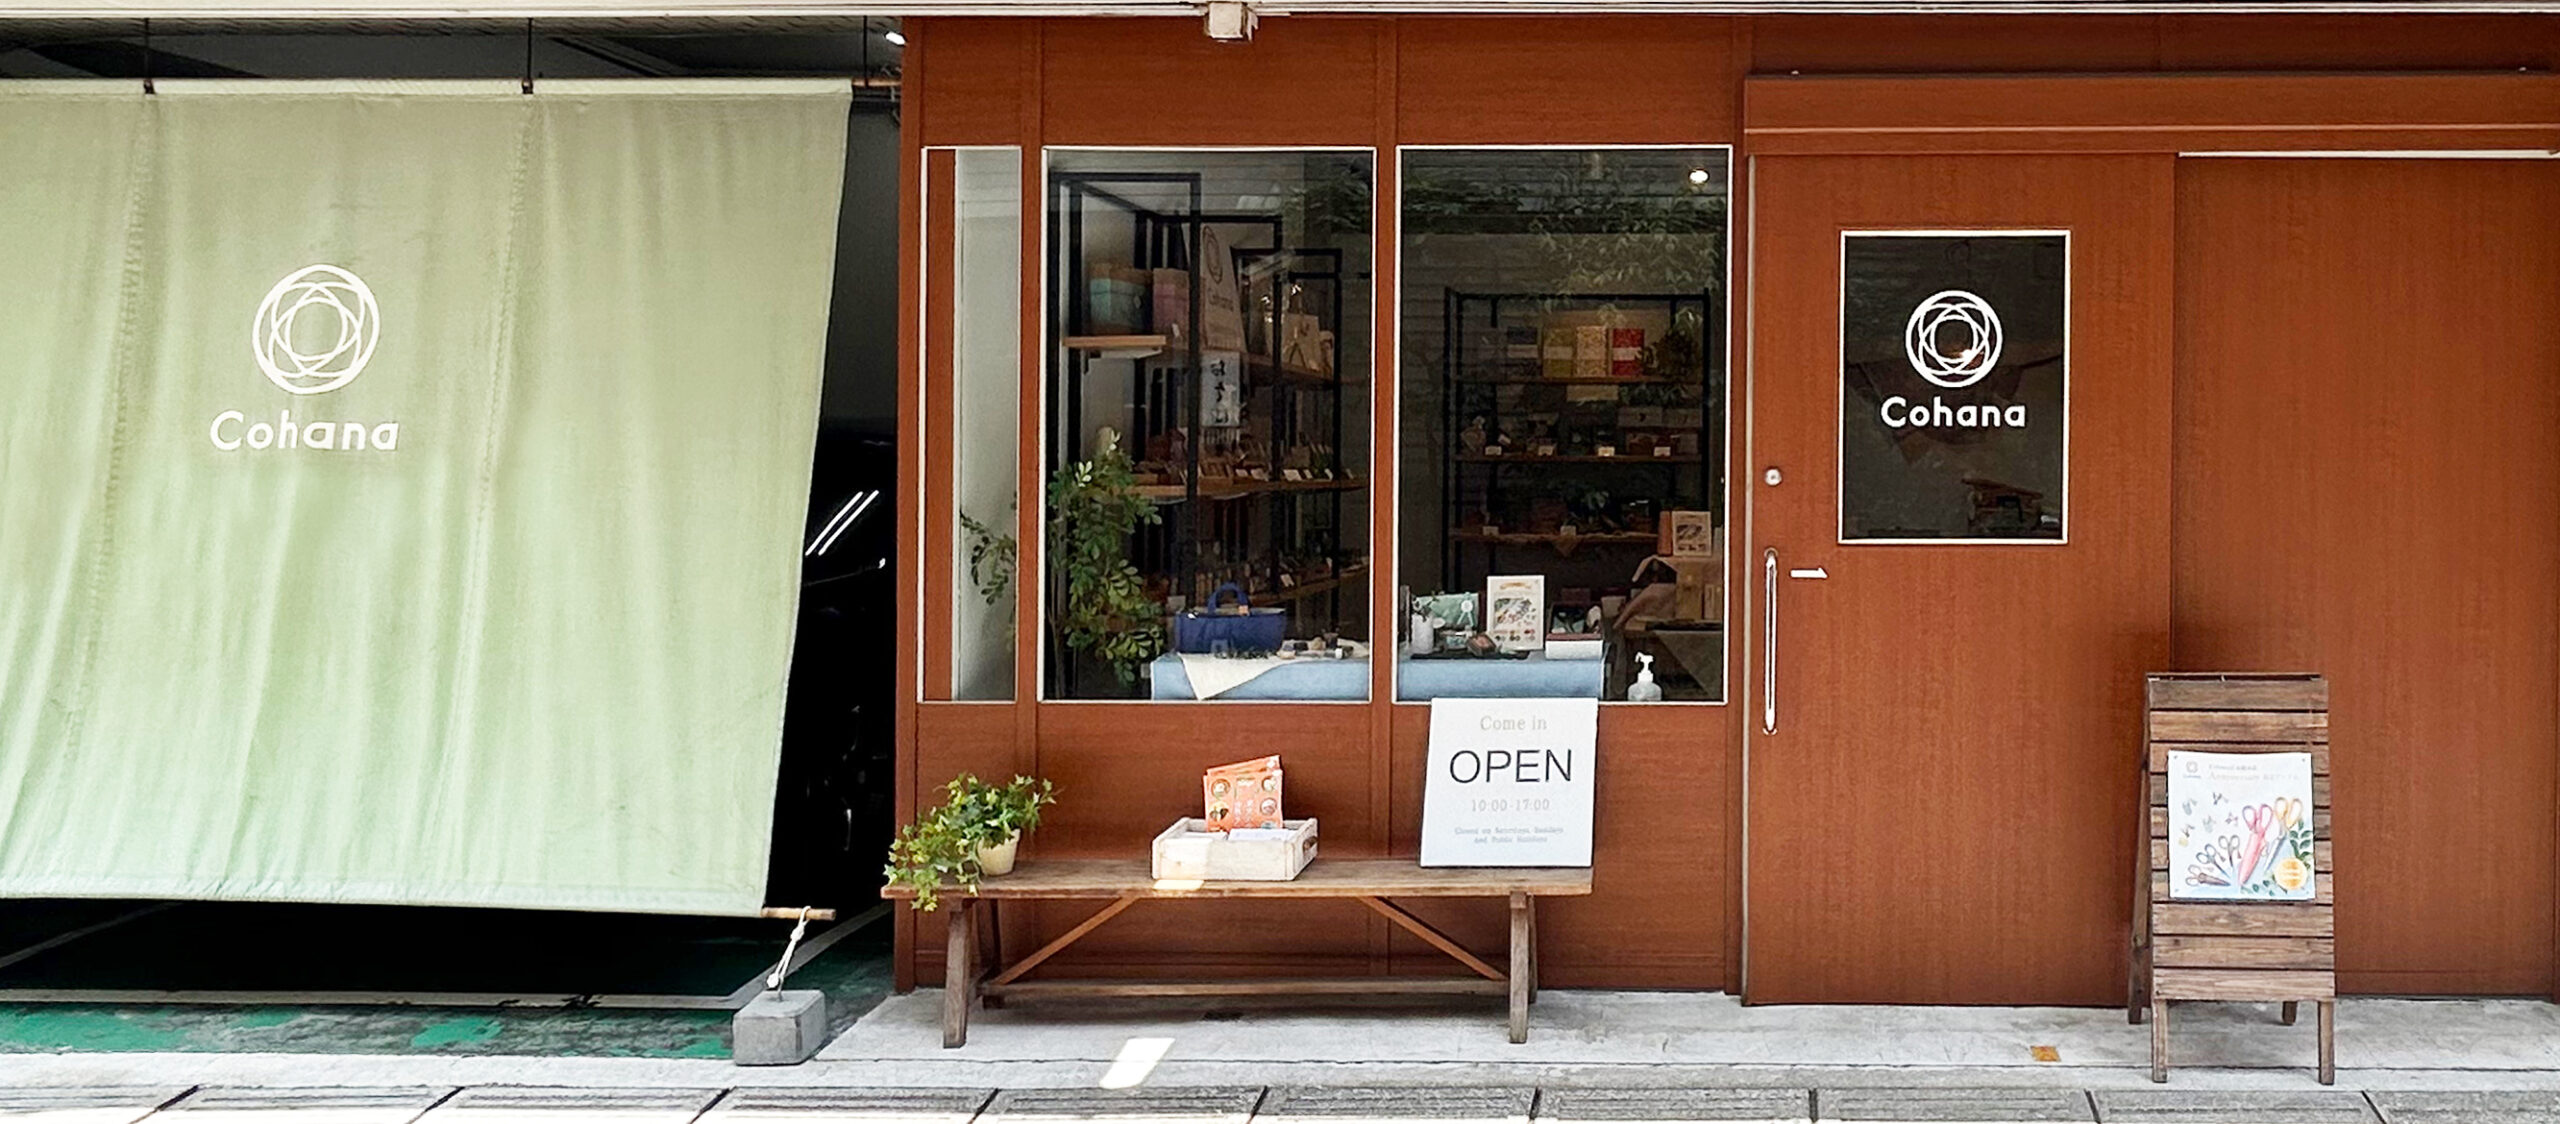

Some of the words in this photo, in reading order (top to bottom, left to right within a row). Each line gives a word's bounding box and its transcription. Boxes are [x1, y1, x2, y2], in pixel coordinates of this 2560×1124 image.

[1880, 395, 2026, 428] Cohana
[210, 410, 399, 450] Cohana
[1480, 715, 1526, 732] Come
[1532, 715, 1548, 732] in
[1449, 748, 1572, 784] OPEN
